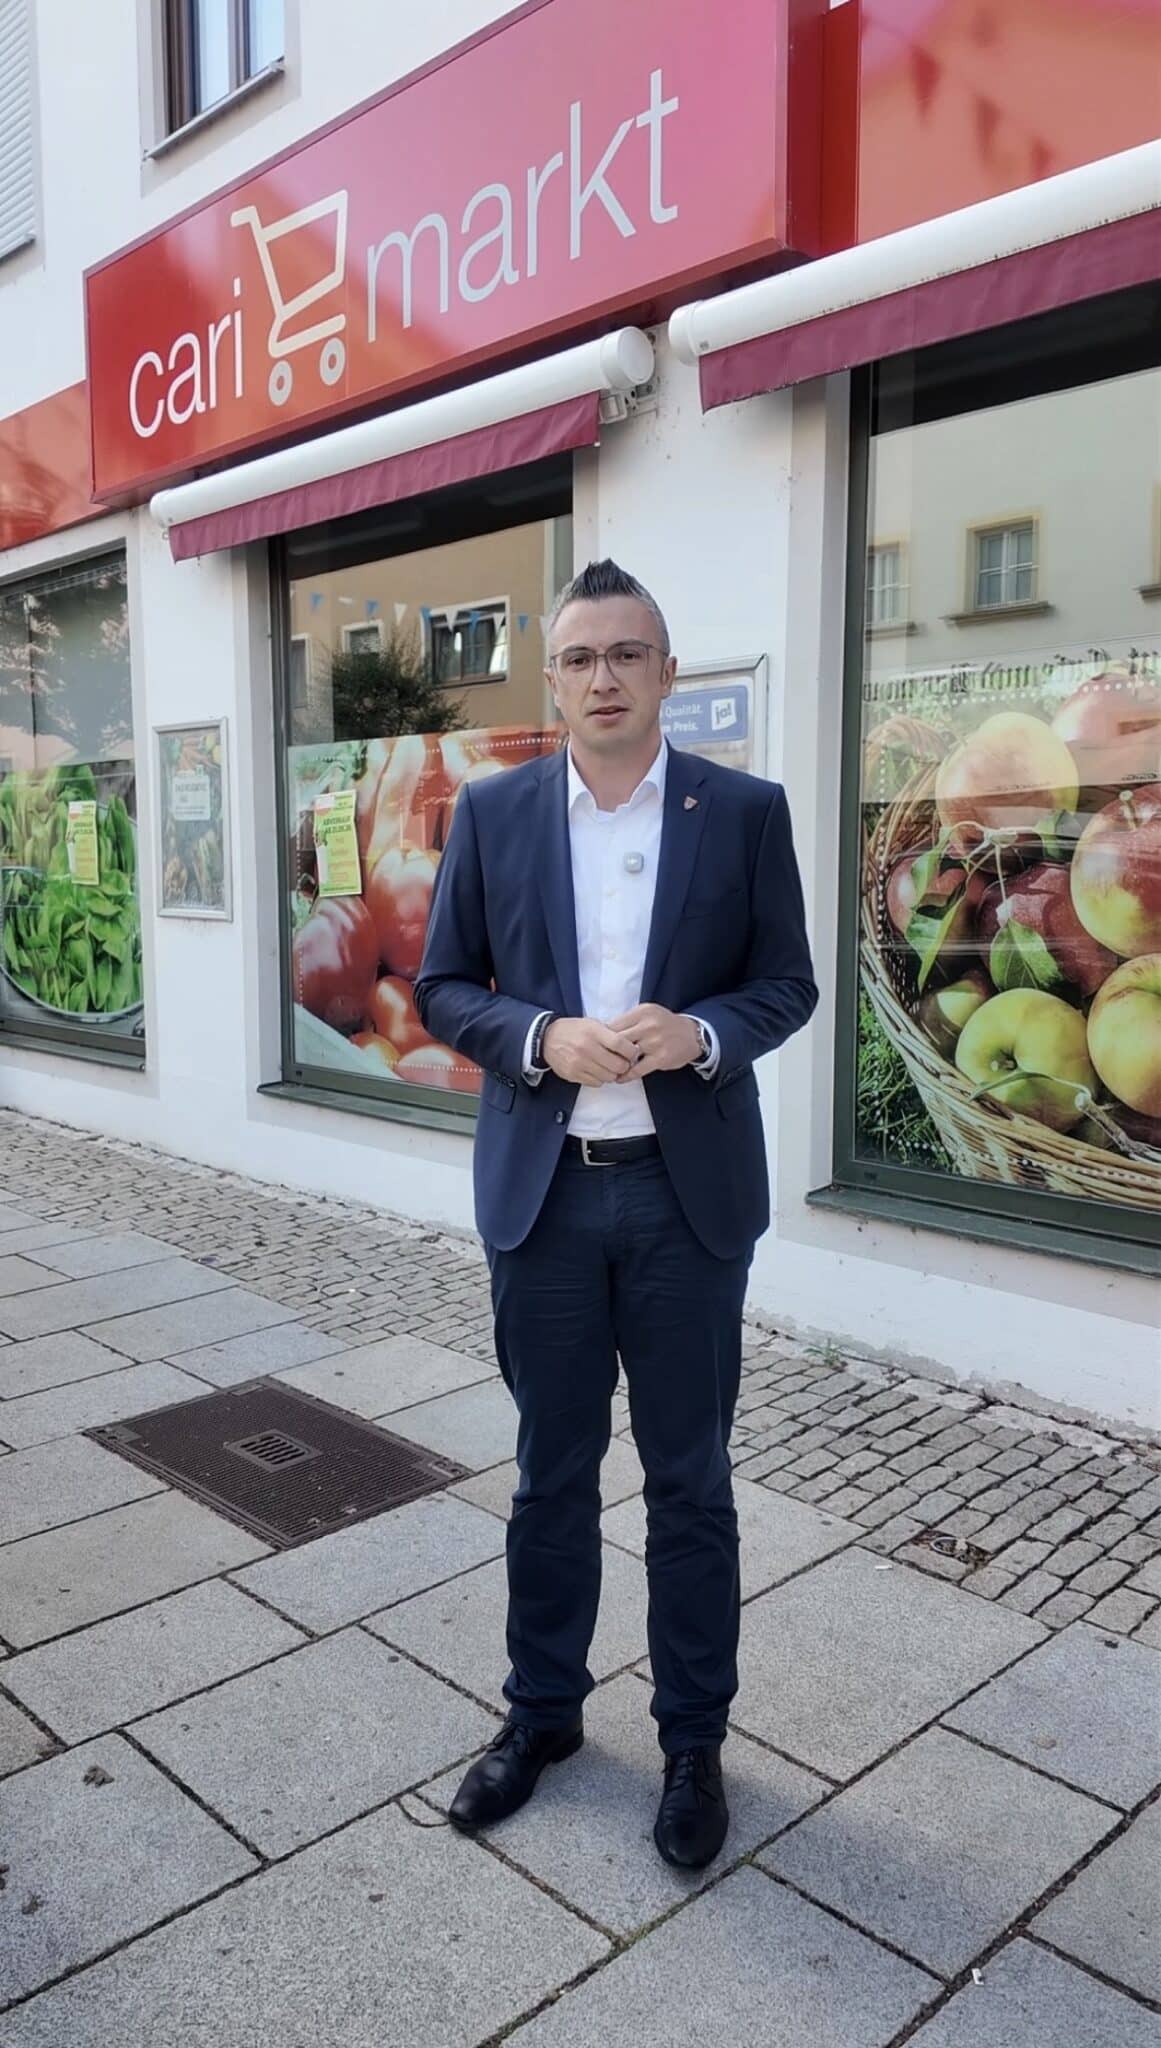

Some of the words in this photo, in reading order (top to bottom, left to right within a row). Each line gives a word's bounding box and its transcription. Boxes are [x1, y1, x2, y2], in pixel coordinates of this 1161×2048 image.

[128, 278, 245, 438] cari
[366, 68, 680, 343] markt
[715, 702, 731, 724] ja!
